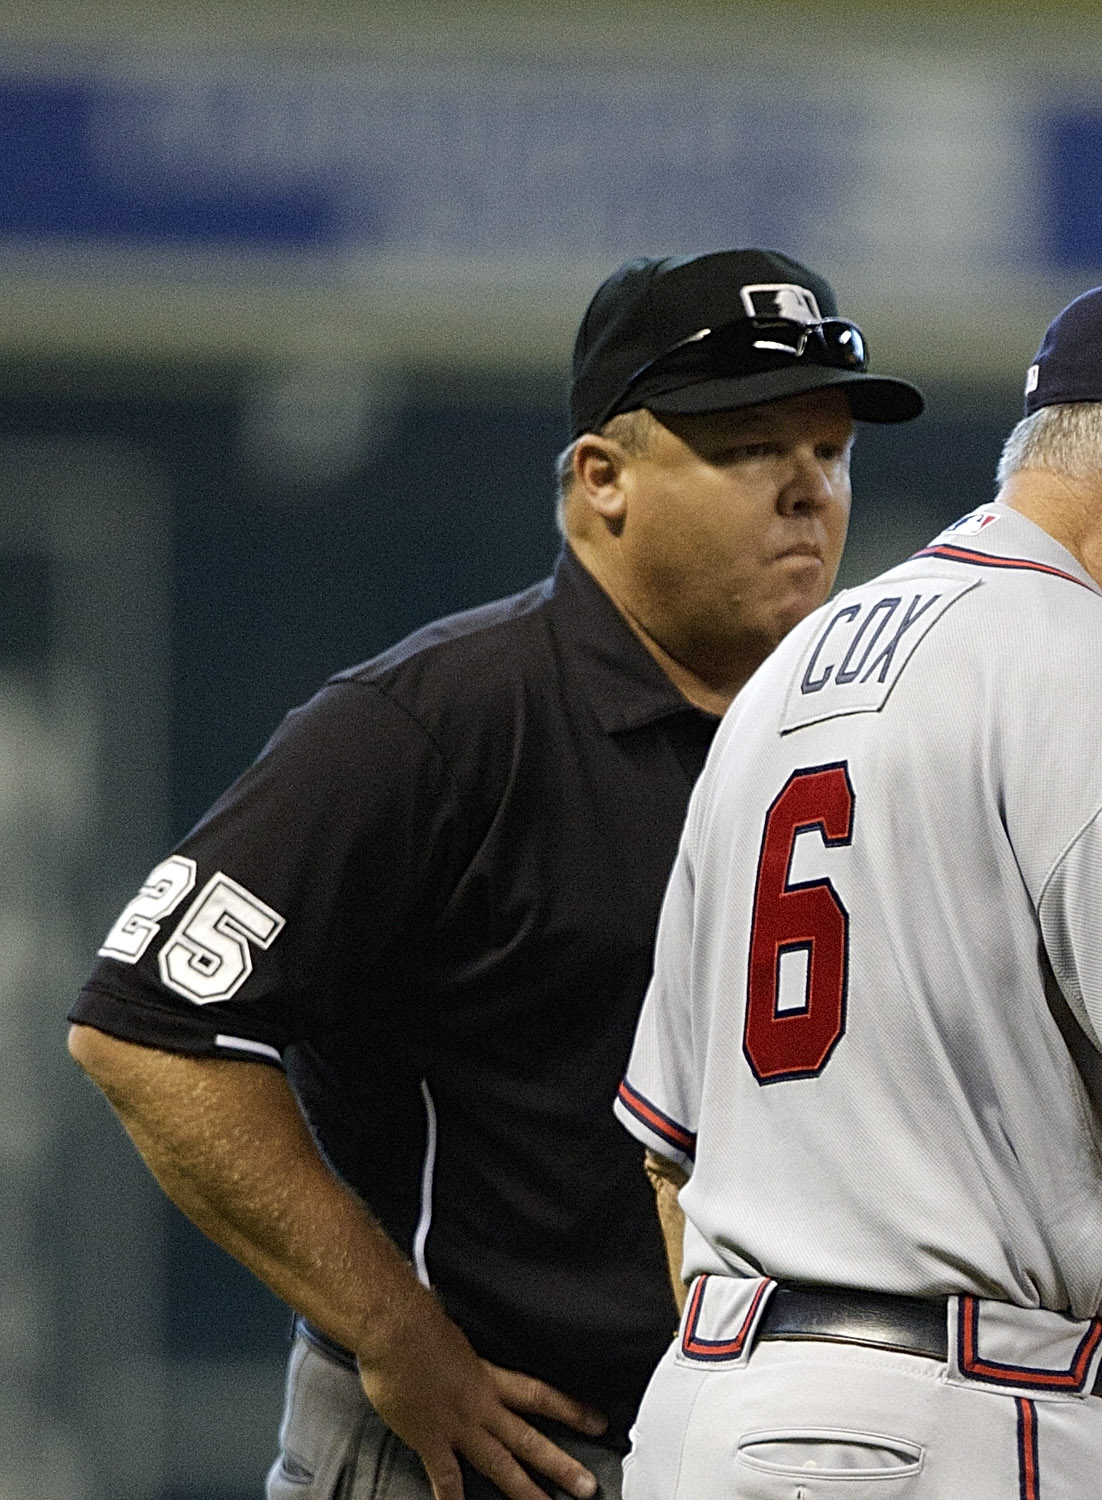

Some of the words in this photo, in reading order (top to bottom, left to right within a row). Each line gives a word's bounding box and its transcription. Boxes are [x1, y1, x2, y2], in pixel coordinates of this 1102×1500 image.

[800, 594, 942, 695] COX
[97, 854, 287, 1006] 25
[742, 759, 856, 1087] 6
